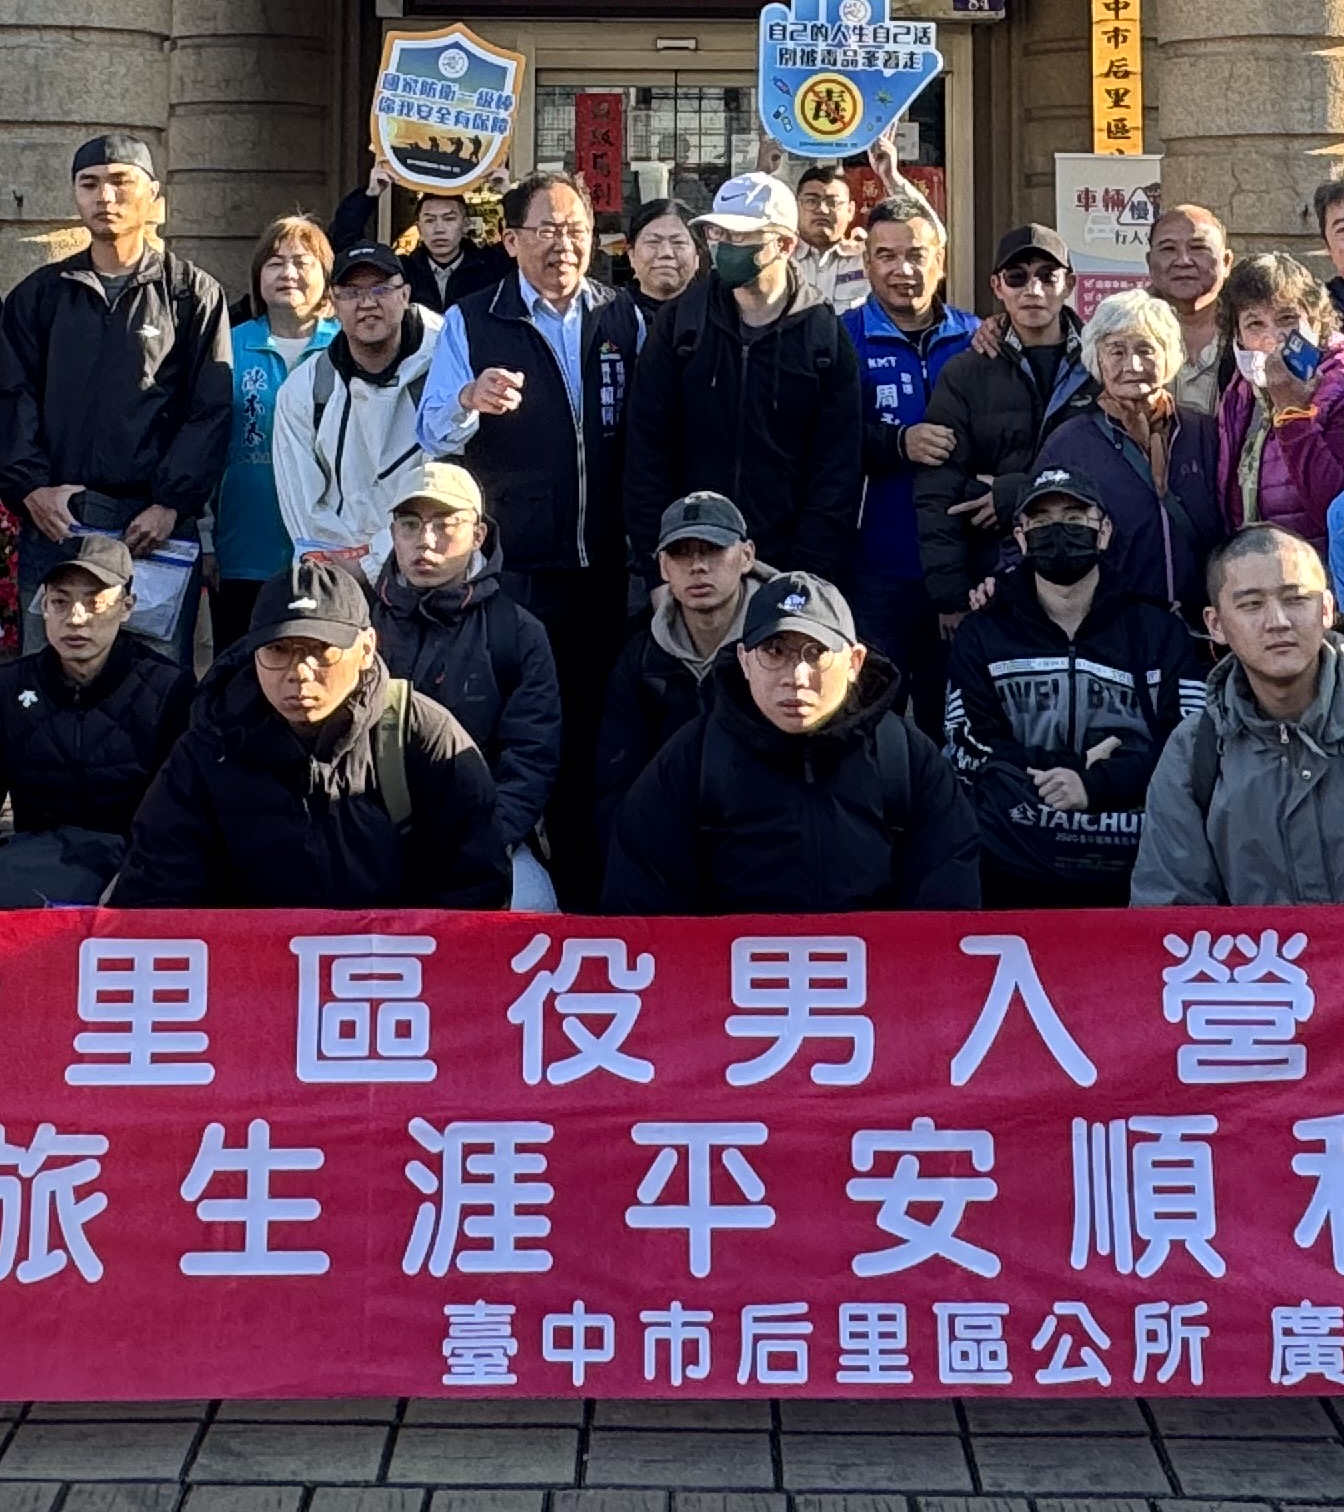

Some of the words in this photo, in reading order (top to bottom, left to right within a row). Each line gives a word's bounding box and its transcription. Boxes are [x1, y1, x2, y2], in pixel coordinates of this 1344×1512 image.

[769, 22, 933, 46] 自己的人生自己活
[1075, 187, 1126, 212] 車輛
[1129, 200, 1150, 221] 慢
[1115, 230, 1150, 246] 行人
[867, 356, 897, 369] KMT
[441, 1299, 1210, 1389] 臺中市后里區公所
